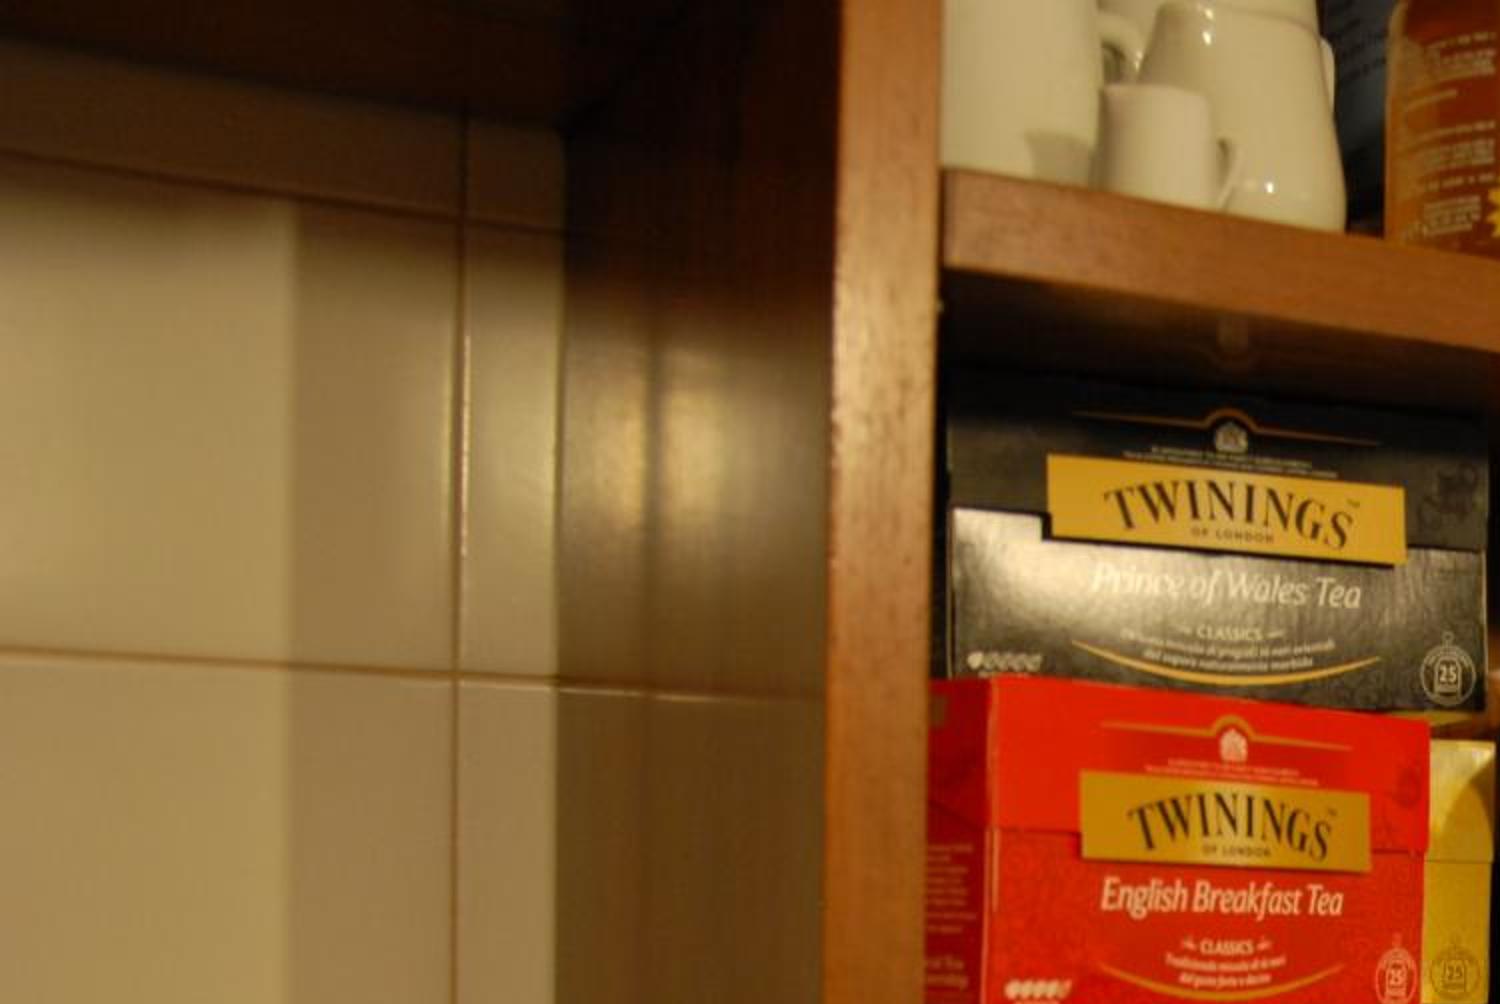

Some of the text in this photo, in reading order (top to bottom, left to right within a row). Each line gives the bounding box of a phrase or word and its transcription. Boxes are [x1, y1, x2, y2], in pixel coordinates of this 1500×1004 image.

[1104, 479, 1354, 551] TWININGS
[1215, 528, 1275, 545] LONDON
[1090, 561, 1362, 610] Prince of Wales Tea
[1195, 623, 1264, 642] CLASSICS
[1438, 663, 1458, 685] 25
[1127, 791, 1333, 863] TWININGS
[1221, 845, 1272, 858] LONDON
[1101, 875, 1345, 922] English Breakfast Tea
[1199, 938, 1256, 956] CLASSICS
